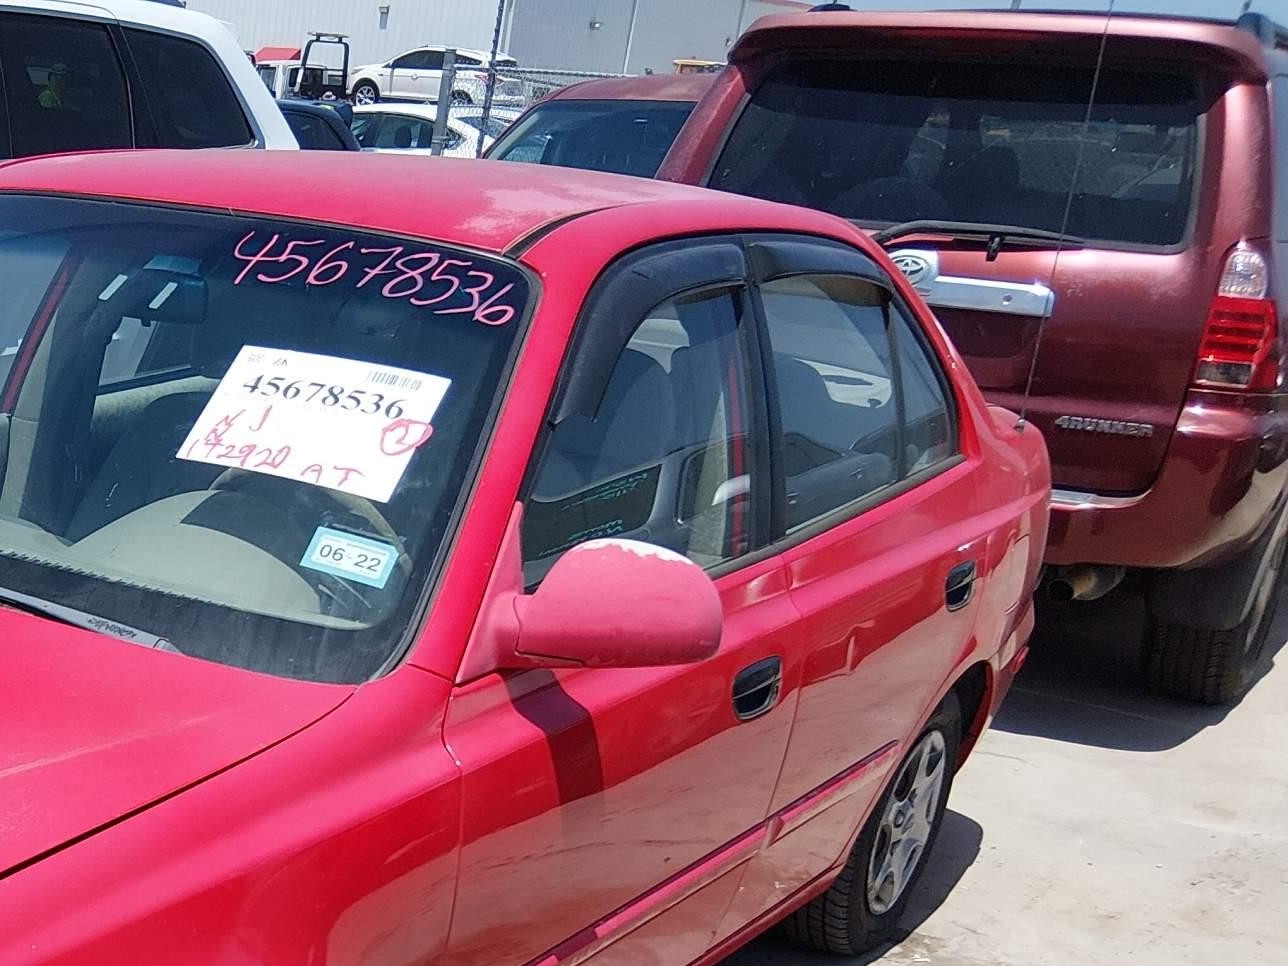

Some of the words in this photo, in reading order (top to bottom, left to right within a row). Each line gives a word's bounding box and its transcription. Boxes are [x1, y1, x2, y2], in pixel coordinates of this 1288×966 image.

[234, 231, 514, 325] 45678536
[243, 374, 405, 419] 45678536
[1054, 415, 1153, 437] 4RUNNER
[319, 544, 346, 562] 06
[354, 553, 381, 573] 22
